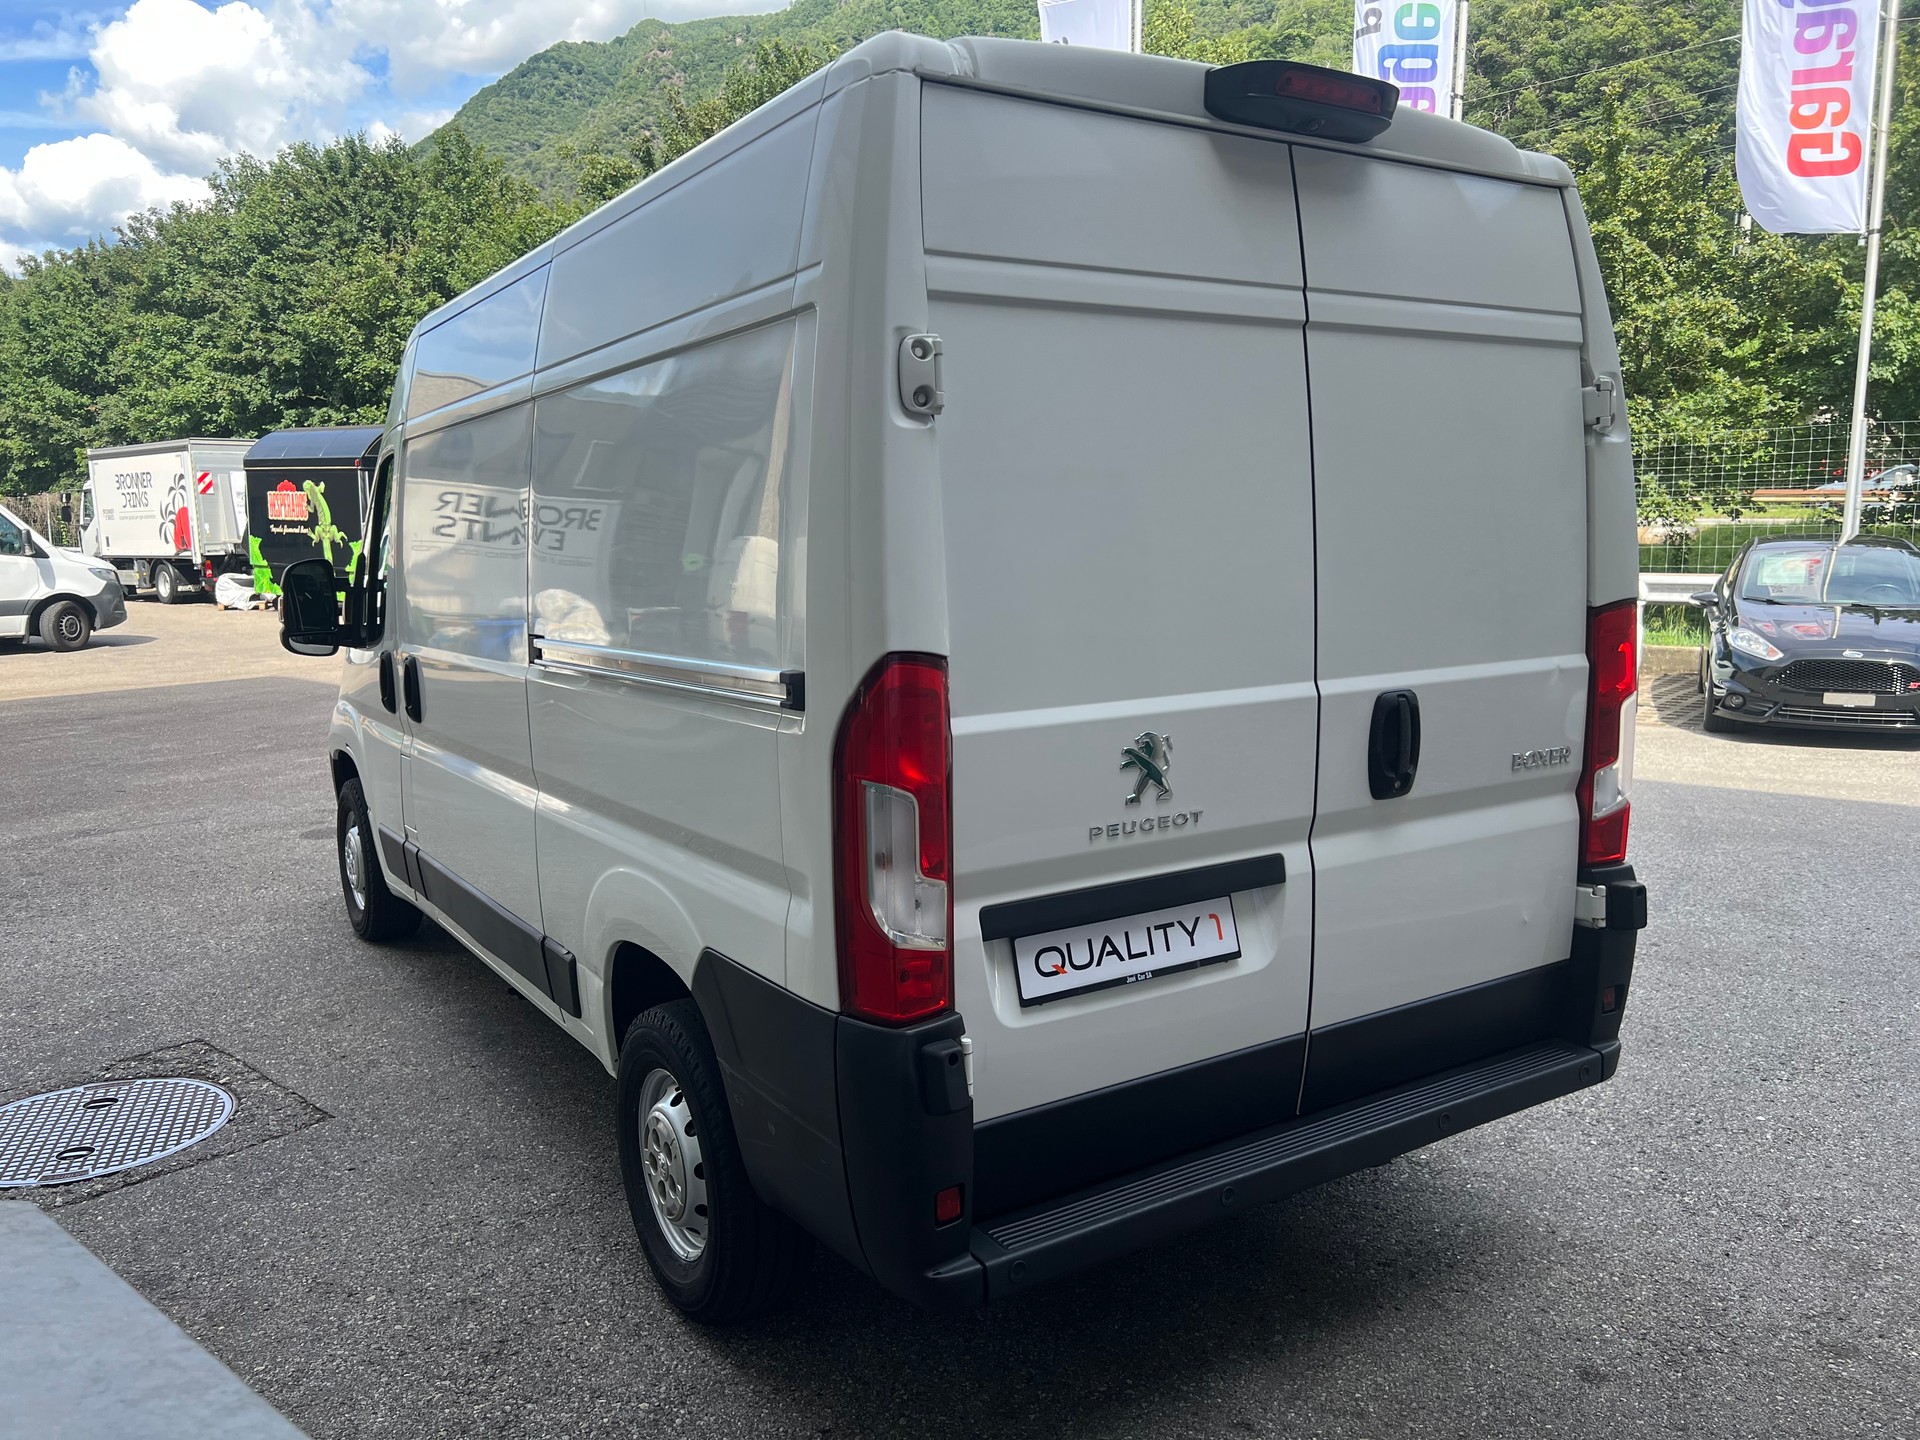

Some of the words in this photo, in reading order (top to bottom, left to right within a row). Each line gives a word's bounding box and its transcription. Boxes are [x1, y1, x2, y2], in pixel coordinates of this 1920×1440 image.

[1512, 746, 1571, 772] BOXER
[1089, 811, 1204, 844] PEUGEOT
[1034, 917, 1200, 978] QUALITY
